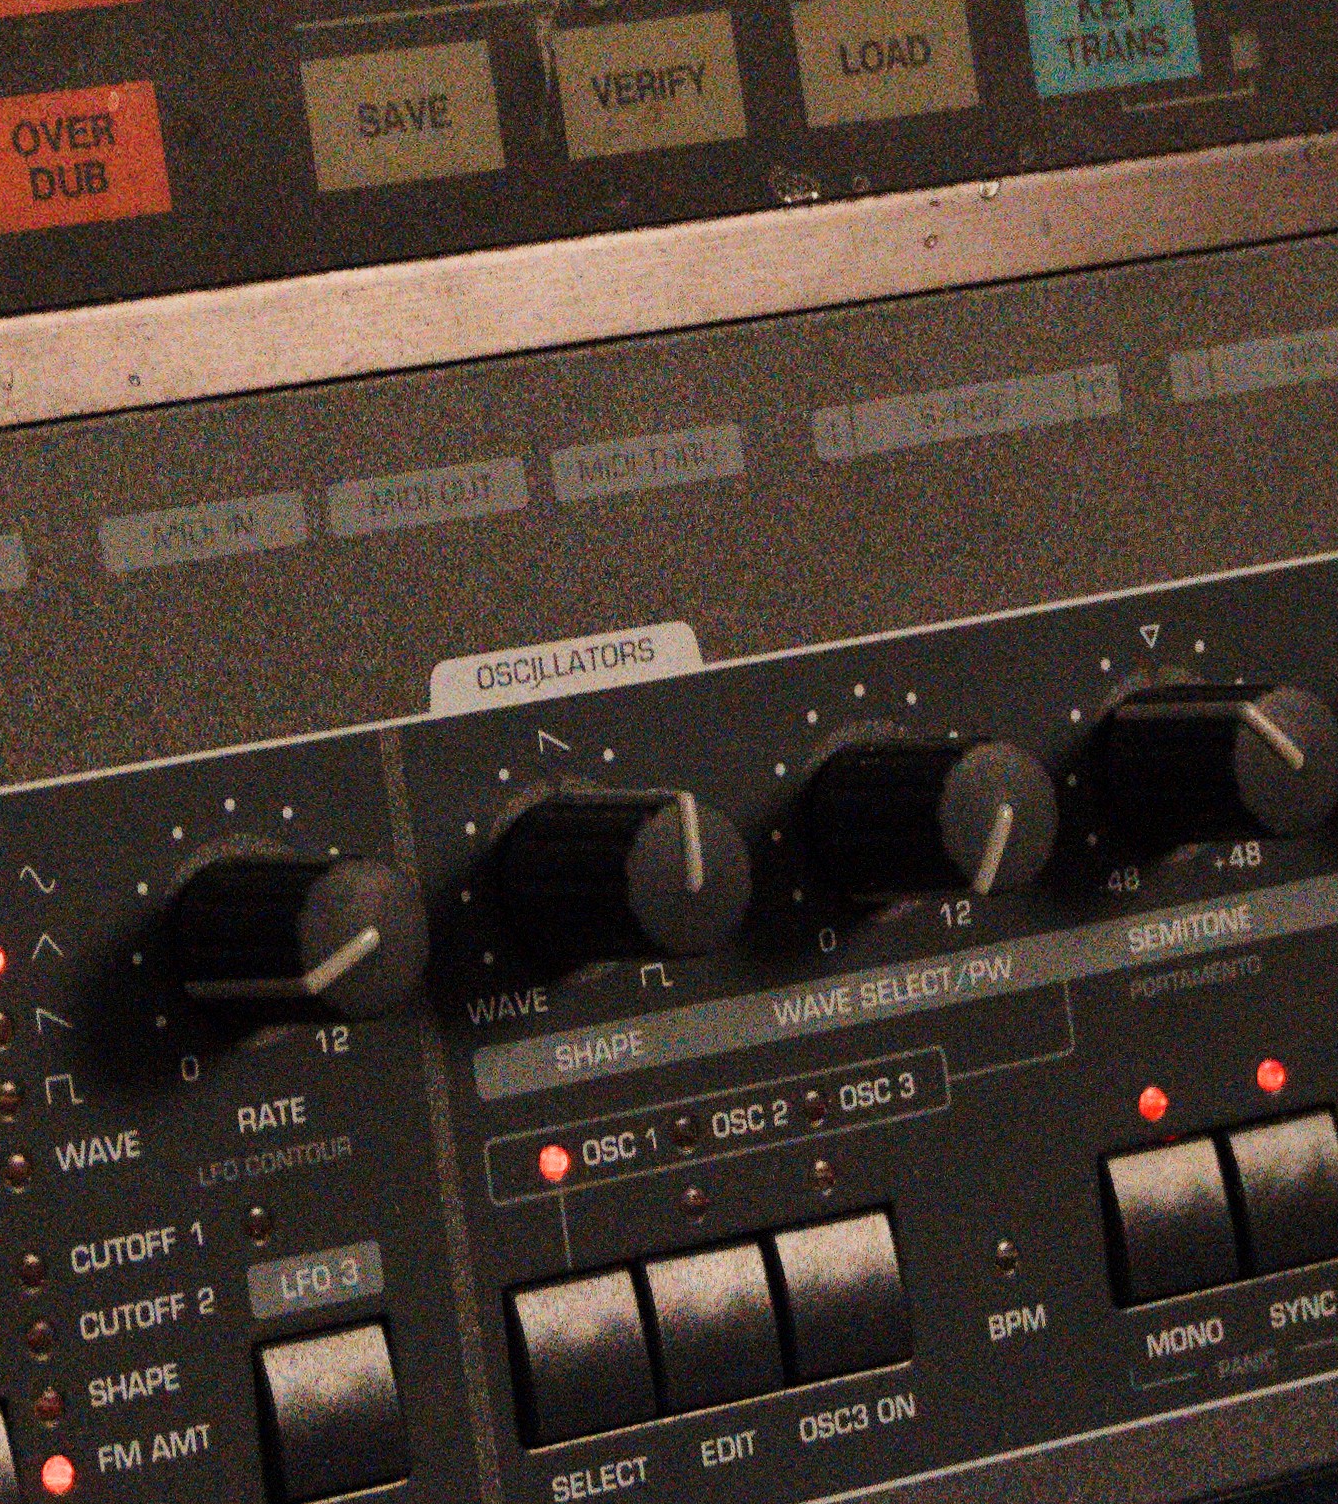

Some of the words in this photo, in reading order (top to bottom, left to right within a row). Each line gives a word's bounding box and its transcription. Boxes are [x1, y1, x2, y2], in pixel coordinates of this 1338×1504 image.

[838, 34, 932, 77] LOAD
[1062, 23, 1170, 69] TRANS
[590, 62, 707, 110] VERIFY
[10, 113, 116, 159] OVER
[358, 93, 452, 140] SAVE
[29, 160, 109, 202] DUB
[476, 637, 655, 694] OSCILLATORS
[1127, 904, 1252, 955] SEMITONE
[773, 985, 853, 1027] WAVE
[858, 954, 1014, 1011] SELECT/PW
[315, 1026, 350, 1054] 12
[554, 1029, 645, 1073] SHAPE
[54, 1130, 141, 1172] WAVE
[280, 1264, 333, 1301] LFO
[340, 1258, 360, 1286] 3
[987, 1303, 1047, 1342] BPM
[1146, 1317, 1224, 1359] MONO
[1269, 1290, 1337, 1329] SYNC
[88, 1362, 180, 1408] SHAPE
[97, 1439, 143, 1472] FM
[151, 1424, 211, 1463] AMT
[550, 1455, 648, 1503] SELECT
[700, 1430, 756, 1468] EDIT
[798, 1403, 870, 1444] OSC3
[876, 1393, 916, 1426] ON
